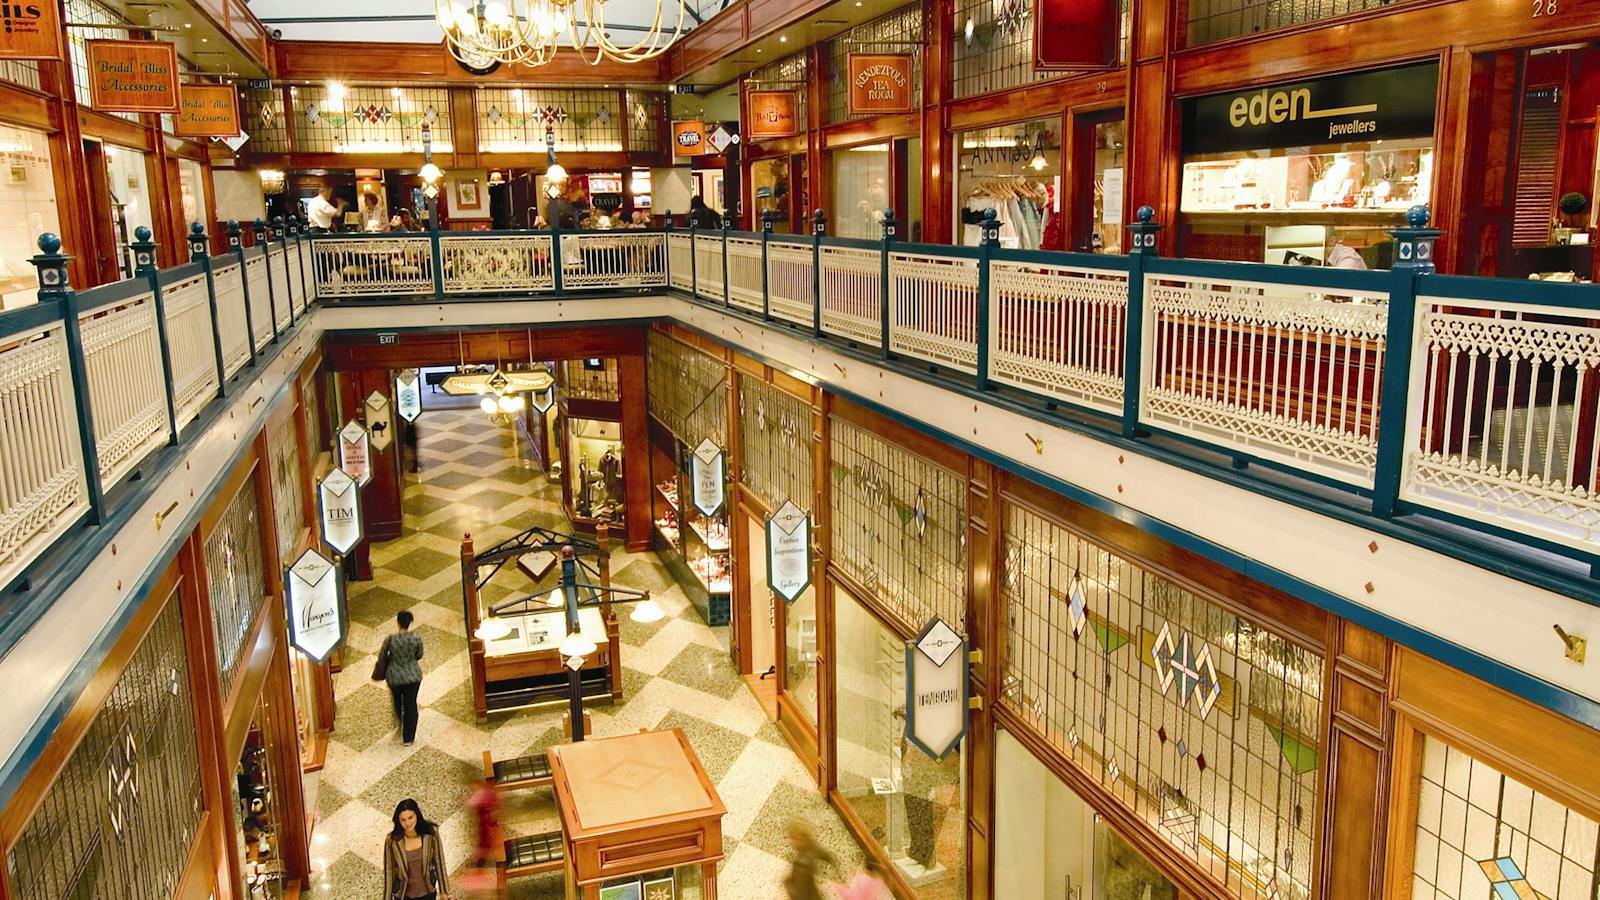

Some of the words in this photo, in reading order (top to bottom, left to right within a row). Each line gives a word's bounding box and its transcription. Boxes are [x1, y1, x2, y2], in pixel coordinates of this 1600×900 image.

[1532, 0, 1557, 18] 28
[97, 61, 133, 74] Bridal
[141, 63, 168, 75] Bliss
[856, 64, 907, 88] RENDEZVOUS
[102, 79, 168, 92] Accessories
[873, 80, 890, 90] TEA
[868, 90, 895, 100] ROOM
[1229, 87, 1311, 128] eden
[1328, 120, 1377, 139] jewellers
[380, 335, 395, 344] EXIT
[327, 507, 353, 519] TIM
